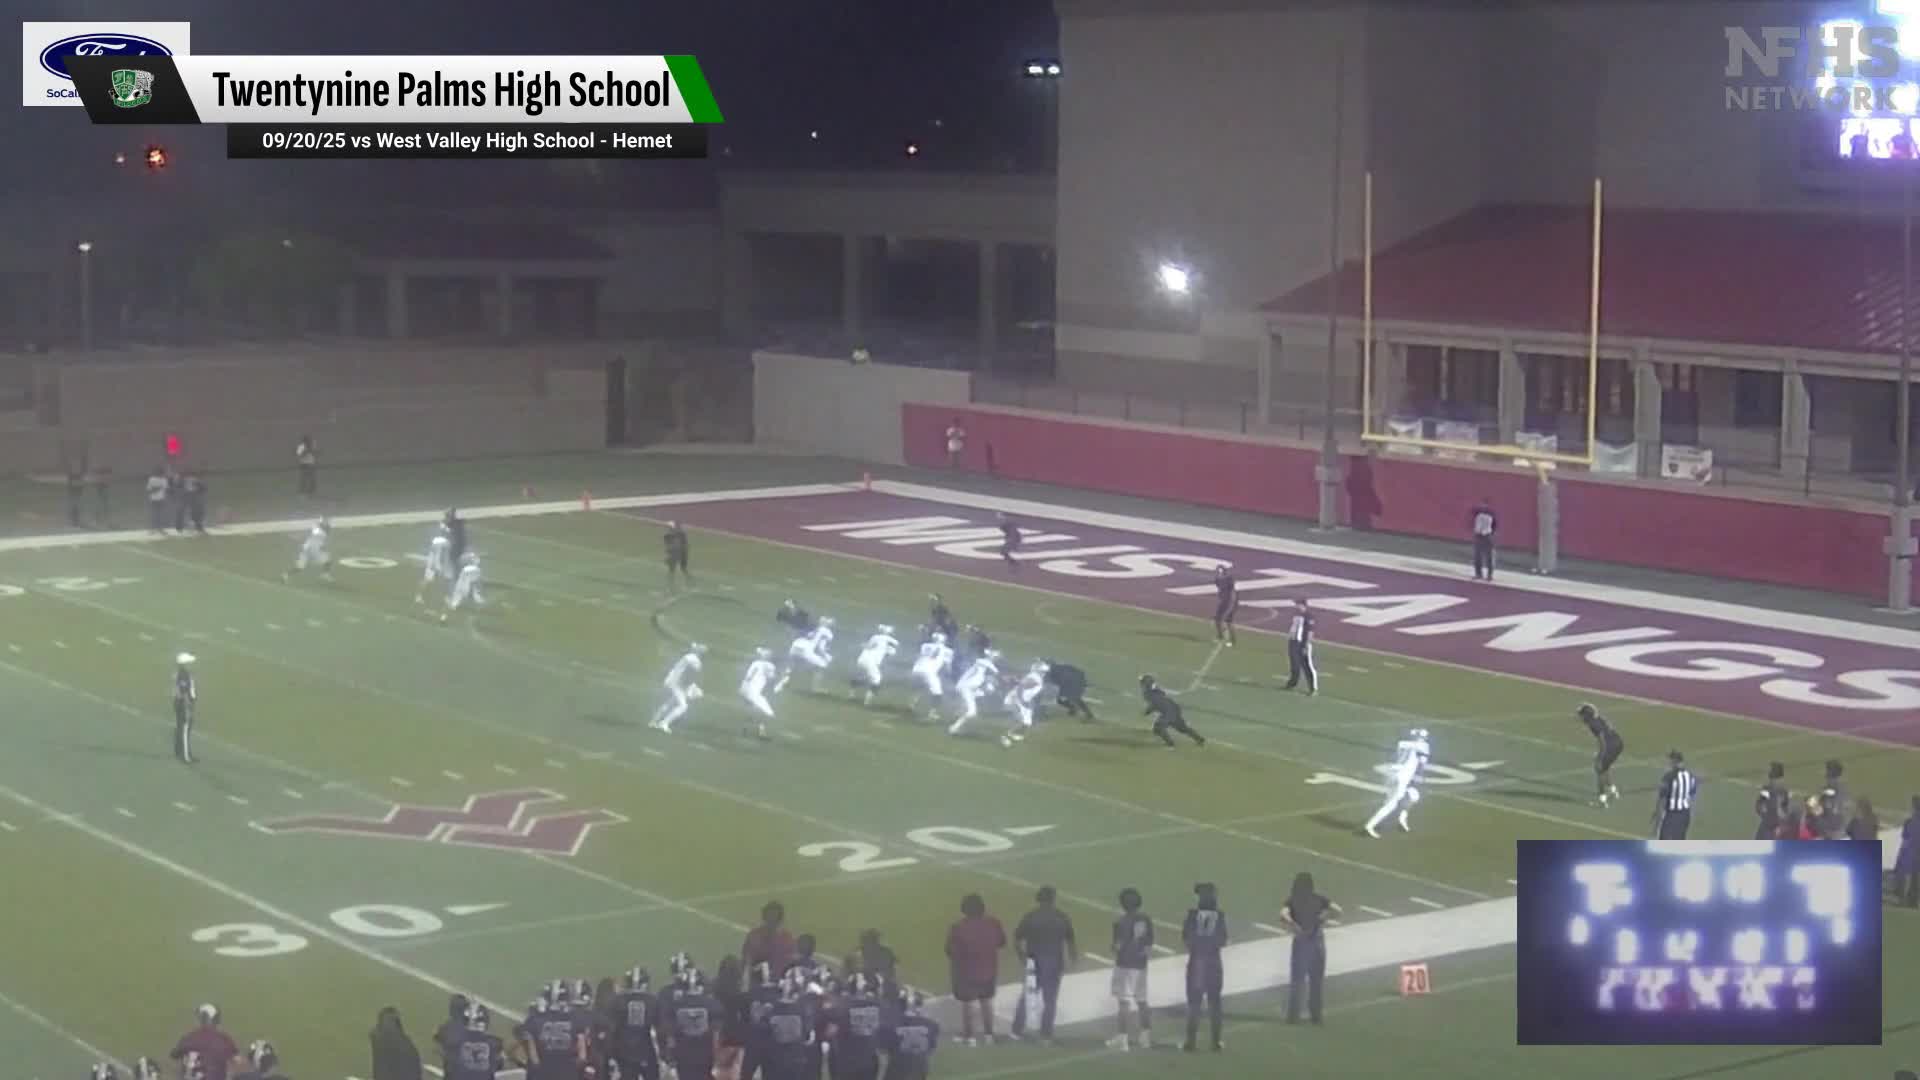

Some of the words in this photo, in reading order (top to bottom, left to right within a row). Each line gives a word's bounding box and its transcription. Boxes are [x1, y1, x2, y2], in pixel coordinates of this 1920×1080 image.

[800, 515, 1920, 709] MUSTANGS
[797, 826, 1014, 872] 20
[191, 904, 443, 957] 30
[1404, 968, 1425, 992] 20
